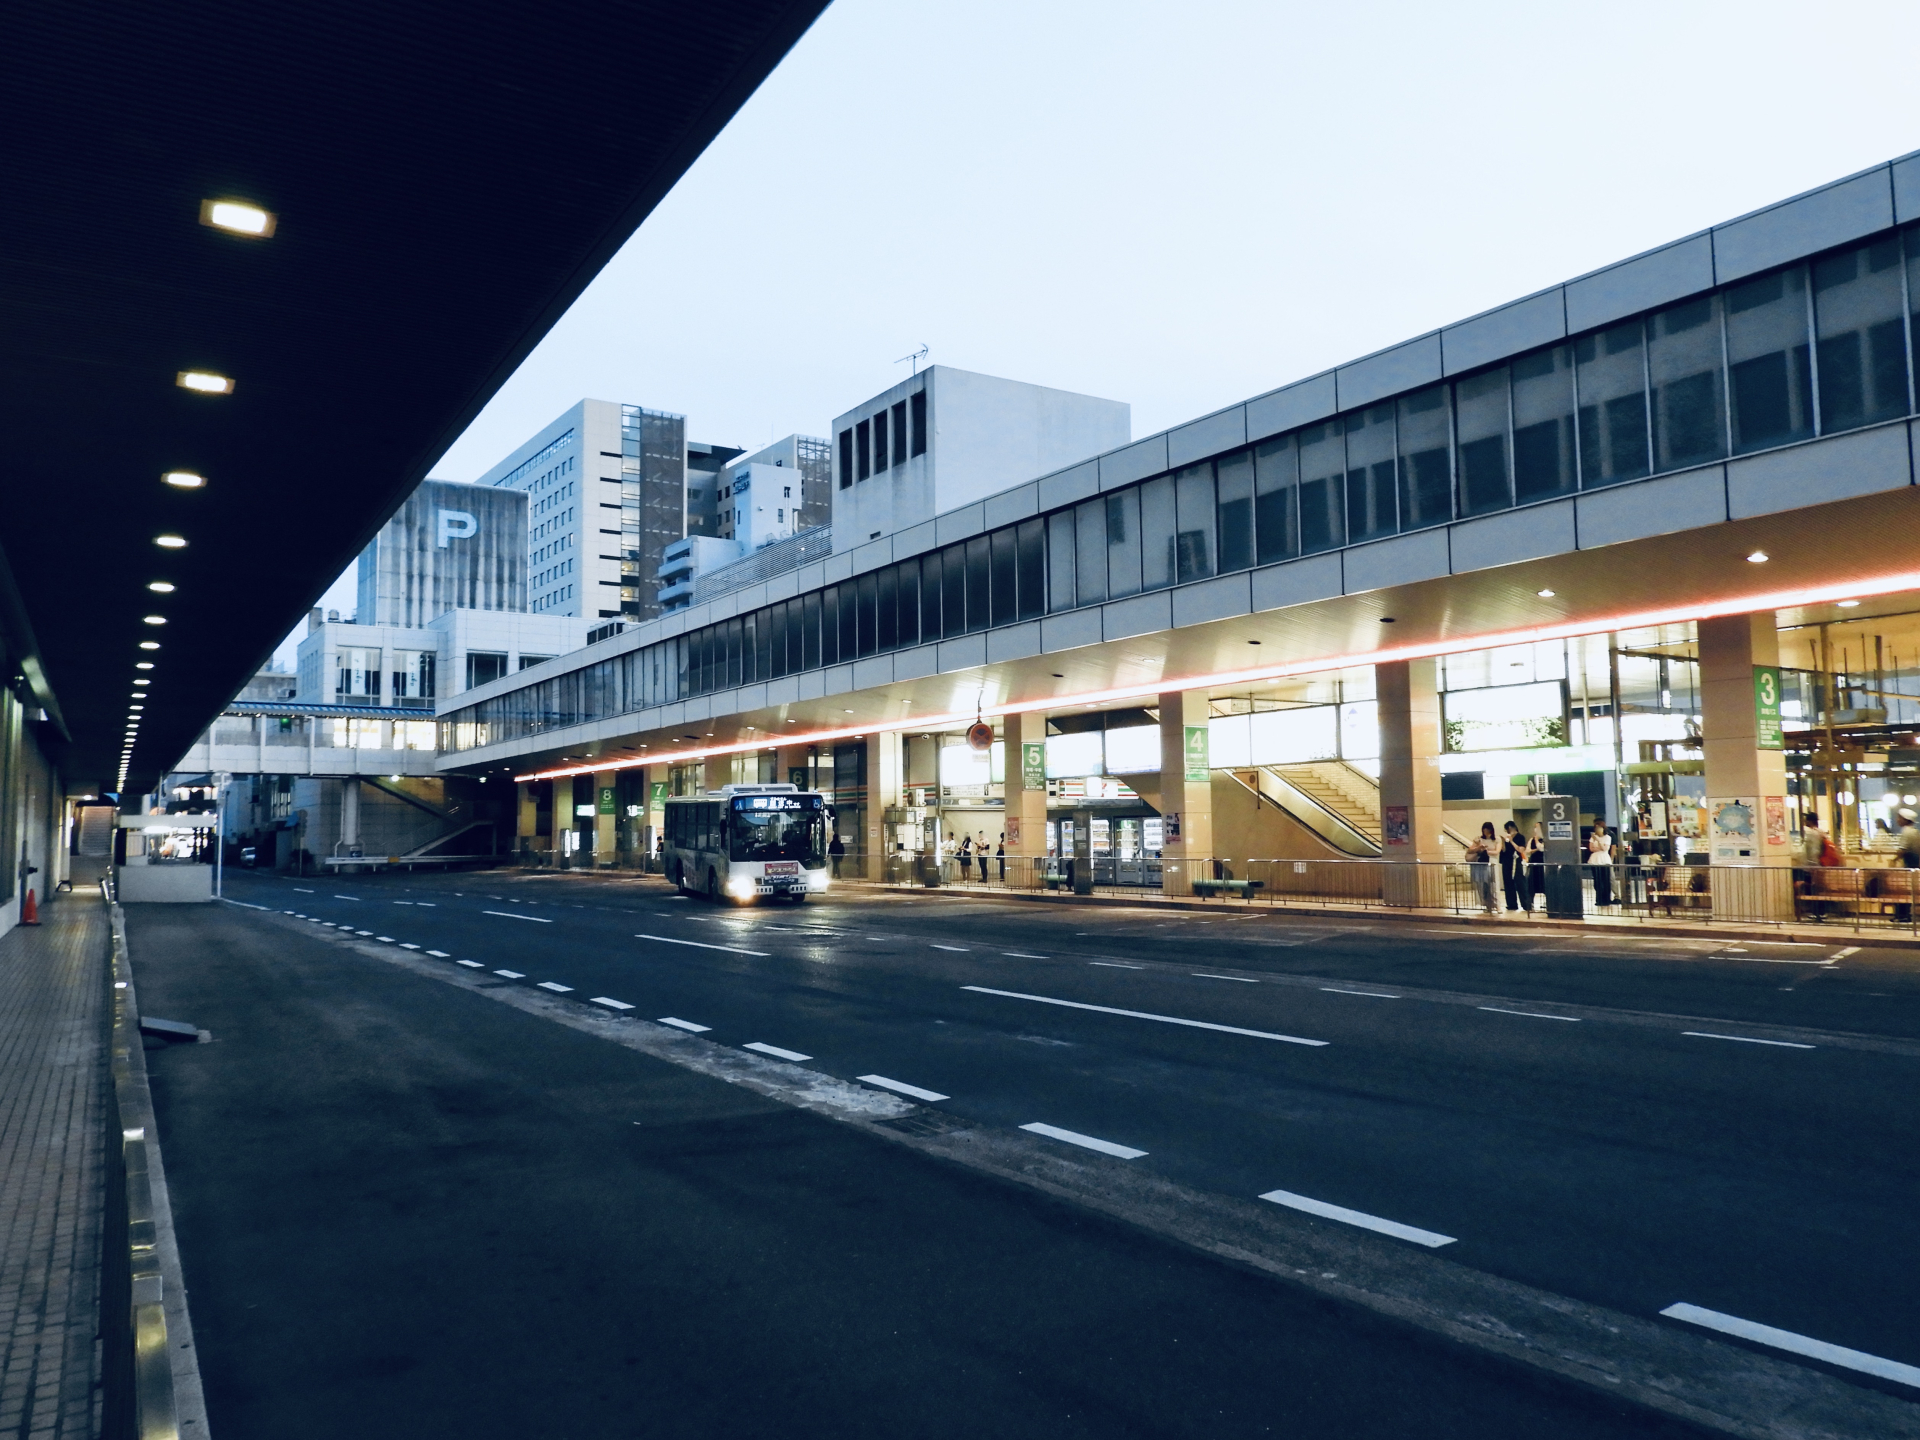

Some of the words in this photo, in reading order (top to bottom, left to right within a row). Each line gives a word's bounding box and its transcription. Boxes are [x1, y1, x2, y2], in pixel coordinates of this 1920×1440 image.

[438, 509, 477, 548] P
[1761, 672, 1775, 706] 3
[1190, 730, 1204, 752] 4
[1028, 746, 1041, 766] 5
[792, 770, 803, 785] 6
[602, 789, 612, 801] 8
[654, 783, 664, 796] 7
[1552, 802, 1565, 821] 3
